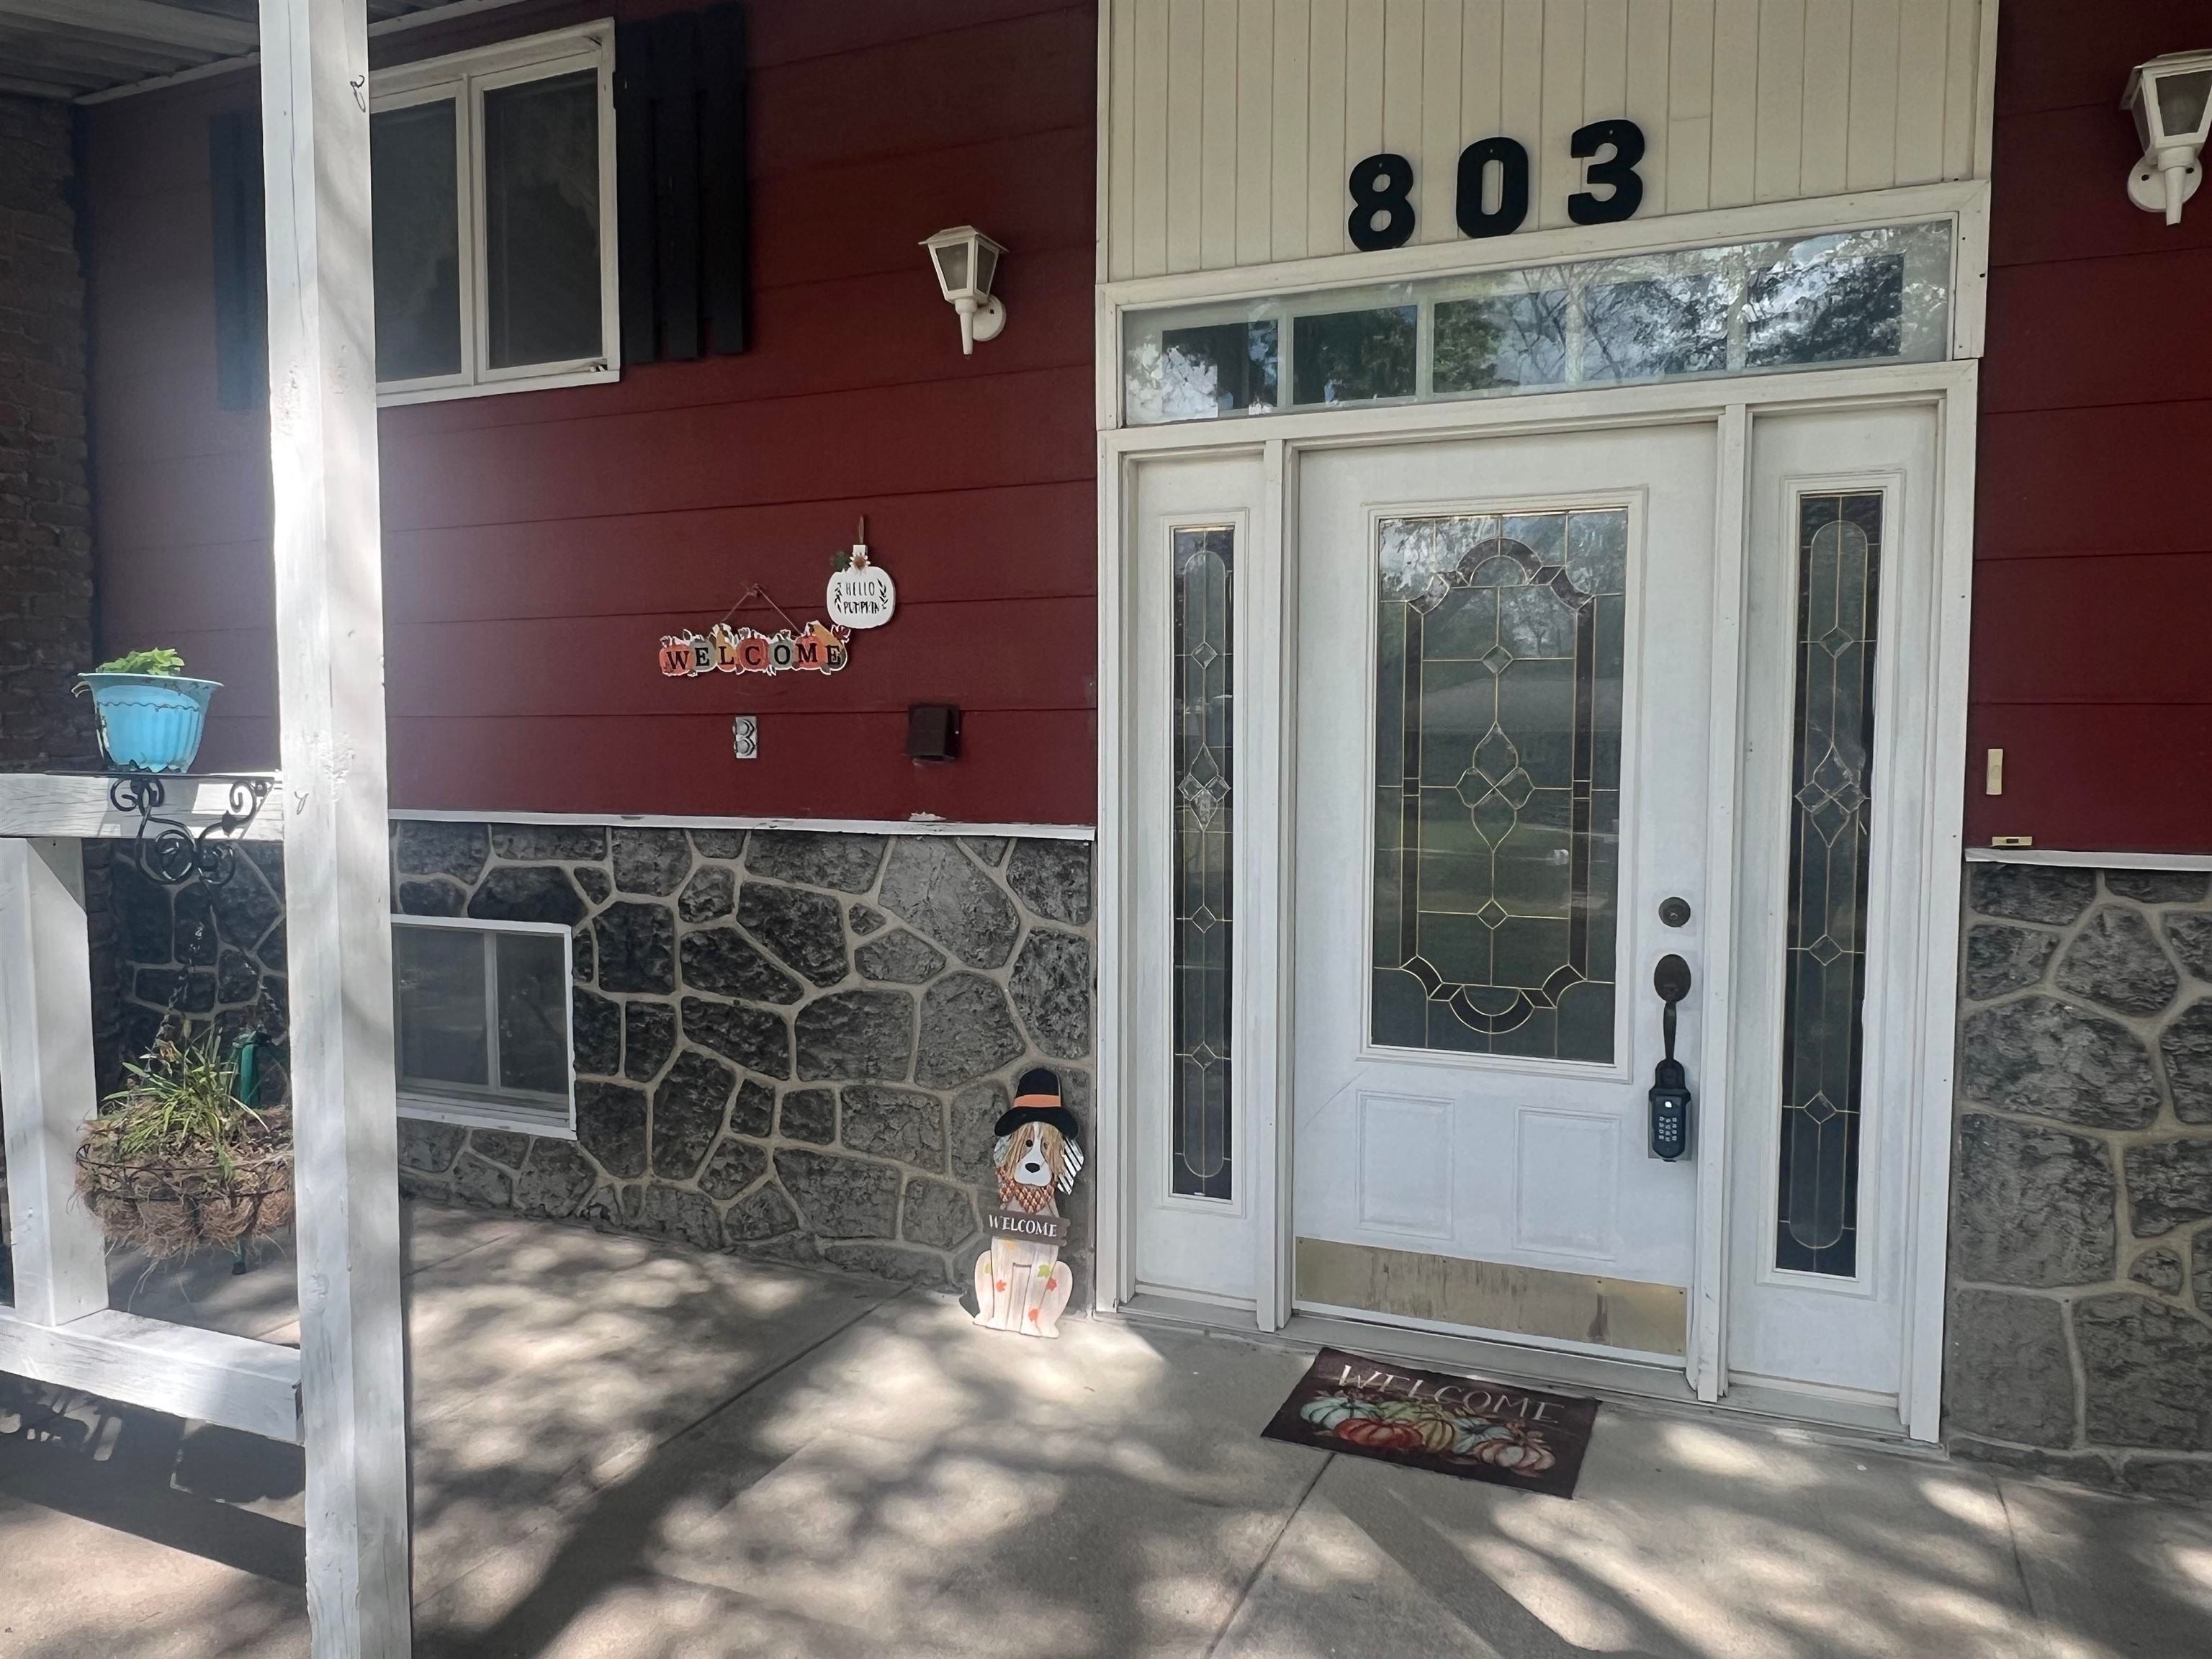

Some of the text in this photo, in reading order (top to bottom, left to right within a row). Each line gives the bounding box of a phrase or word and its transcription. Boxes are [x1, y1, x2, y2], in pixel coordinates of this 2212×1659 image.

[1348, 119, 1645, 252] 803
[845, 581, 875, 596] HELLO
[666, 642, 842, 670] WELCOME
[989, 1214, 1058, 1237] WELCOME
[1338, 1364, 1565, 1424] WELCOME
